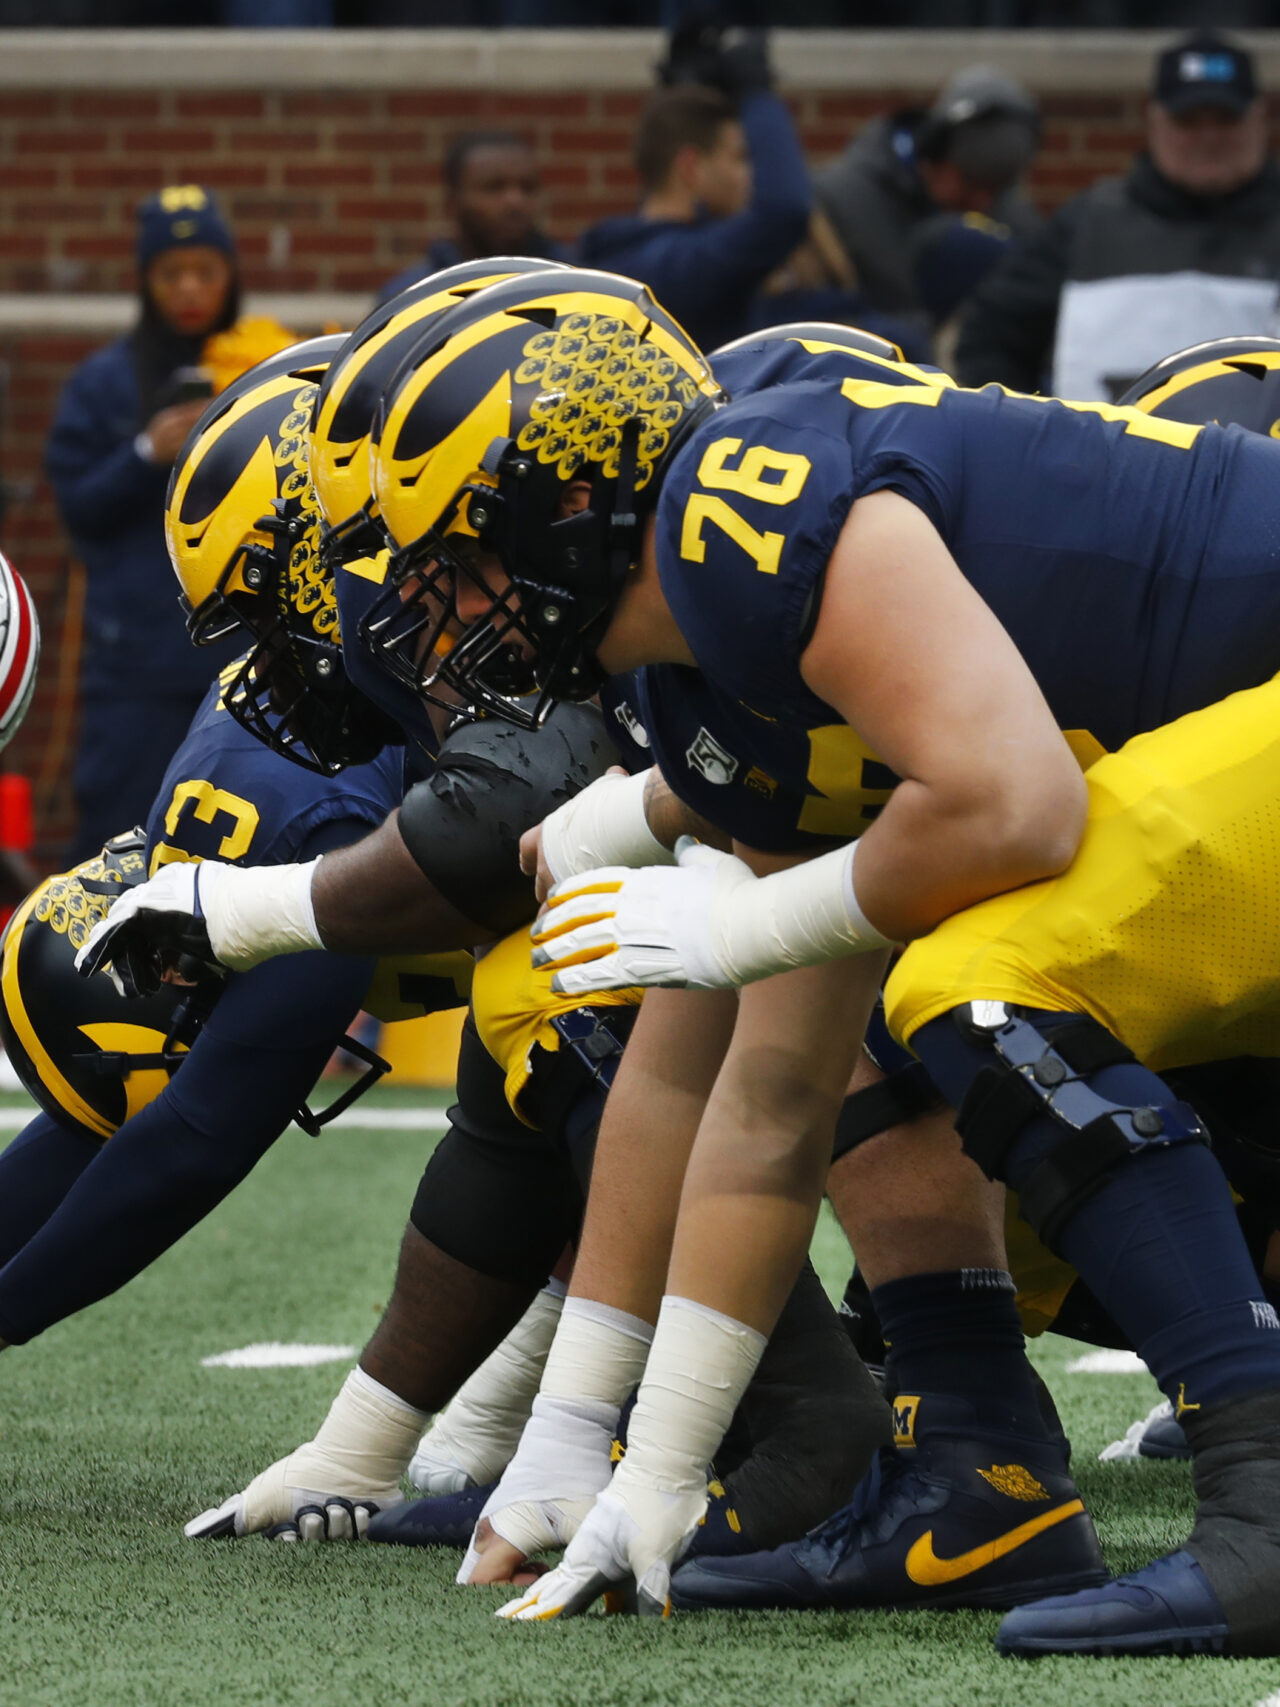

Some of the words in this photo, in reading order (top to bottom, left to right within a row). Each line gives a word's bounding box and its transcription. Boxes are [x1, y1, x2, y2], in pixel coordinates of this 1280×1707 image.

[675, 377, 699, 404] 76
[680, 436, 812, 575] 76
[120, 853, 145, 873] 33
[894, 1406, 912, 1436] M
